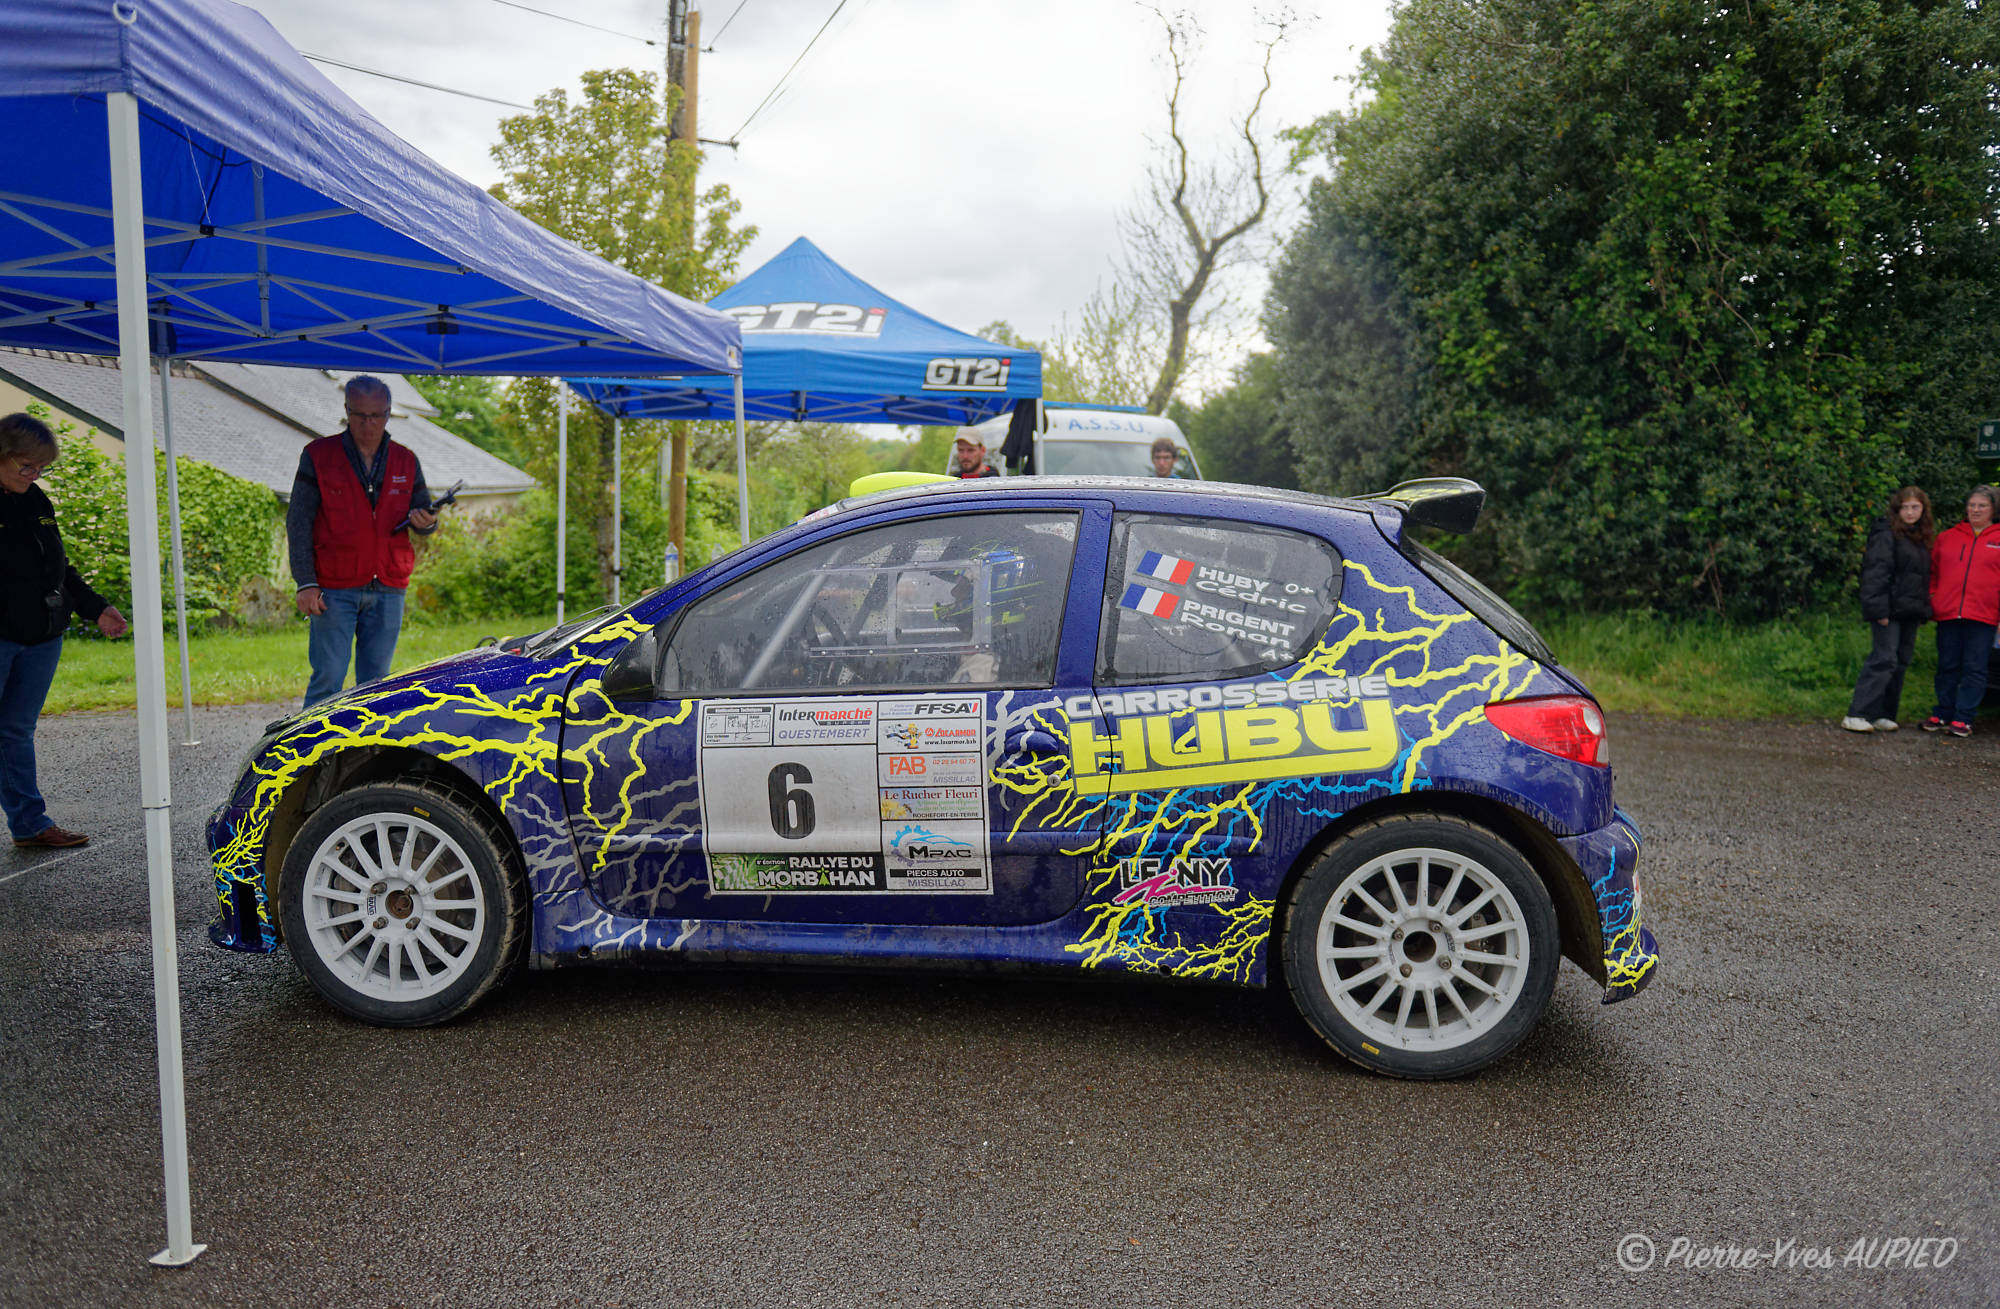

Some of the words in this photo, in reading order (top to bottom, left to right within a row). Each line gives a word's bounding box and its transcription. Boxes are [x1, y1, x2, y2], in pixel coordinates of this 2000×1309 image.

[924, 358, 1011, 389] GT2i
[1198, 566, 1270, 592] HUBY
[1196, 580, 1307, 615] Cédric
[1183, 599, 1295, 635] PRIGENT
[1180, 611, 1291, 649] Ronan
[1261, 648, 1295, 662] A+
[1063, 675, 1389, 719] CARROSSERIE
[779, 708, 873, 725] Intermarché
[914, 703, 970, 715] FFSA
[778, 728, 870, 739] QUESTEMBERT
[1069, 699, 1400, 794] HUBY
[889, 756, 926, 775] FAB
[768, 762, 816, 840] 6
[884, 790, 899, 800] Le
[902, 789, 942, 800] Rucher
[945, 788, 978, 799] Fleuri
[789, 857, 848, 868] RALLYE
[851, 856, 873, 867] DU
[908, 846, 972, 859] MPAC
[908, 879, 966, 887] MISSILLAC
